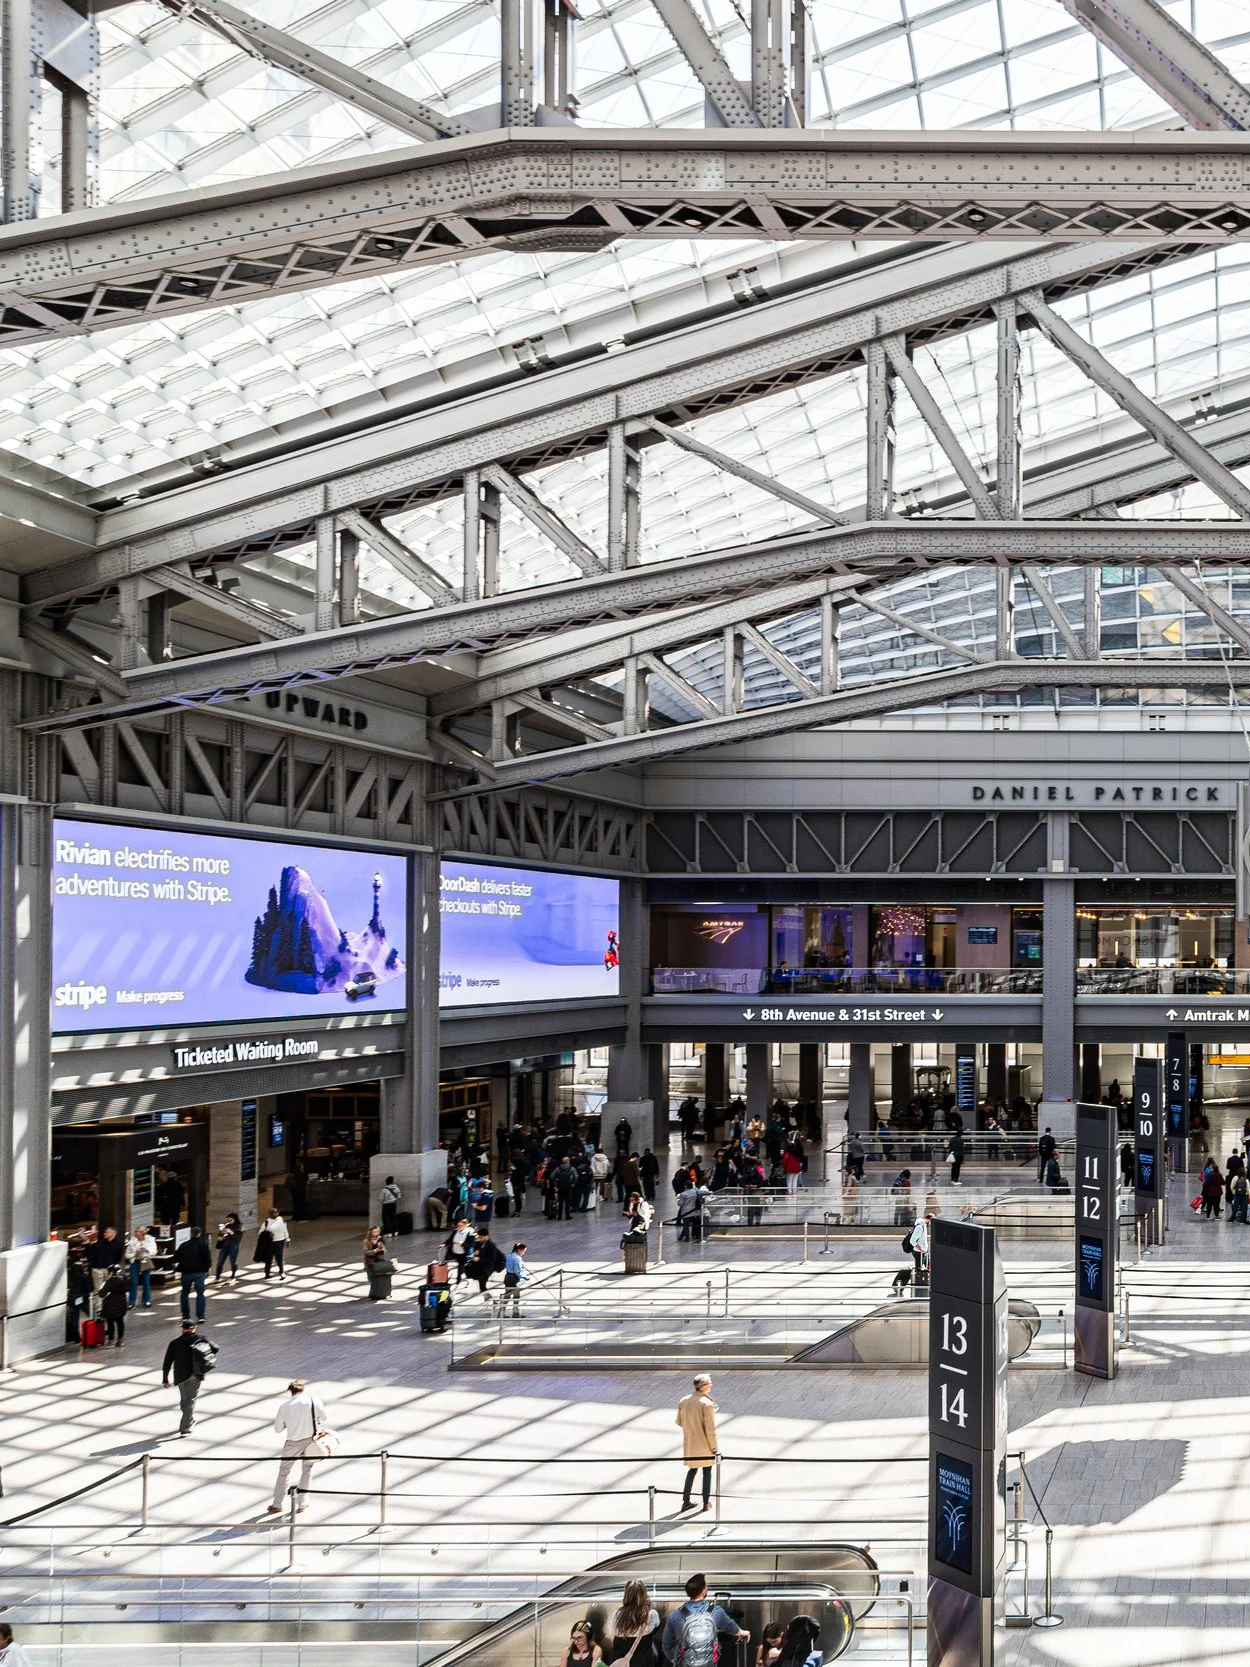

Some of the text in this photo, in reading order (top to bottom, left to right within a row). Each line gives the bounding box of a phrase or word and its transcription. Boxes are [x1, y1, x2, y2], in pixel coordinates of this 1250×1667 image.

[265, 690, 369, 730] UPWARD
[972, 786, 1075, 801] DANIEL
[1094, 786, 1220, 801] PATRICK
[55, 839, 231, 875] Rivian electrifies more
[55, 873, 232, 905] adventures with Stripe.
[439, 875, 533, 897] DoorDash delivers faster
[439, 897, 523, 918] checkouts with Stripe.
[54, 980, 185, 1010] stripe Make progress
[760, 1008, 926, 1021] 8th Avenue & 31st Street
[1184, 1009, 1234, 1022] Amtrak
[175, 1038, 319, 1068] Ticketed Waiting Room
[1172, 1058, 1180, 1071] 7
[1172, 1079, 1180, 1092] 8
[1141, 1092, 1151, 1109] 9
[1139, 1119, 1154, 1137] 10
[1084, 1156, 1099, 1179] 11
[1082, 1195, 1101, 1220] 12
[941, 1313, 968, 1355] 13
[939, 1383, 969, 1429] 14
[938, 1467, 971, 1487] MOYNIHAN
[938, 1475, 957, 1491] TRAIN
[956, 1483, 972, 1495] HALL
